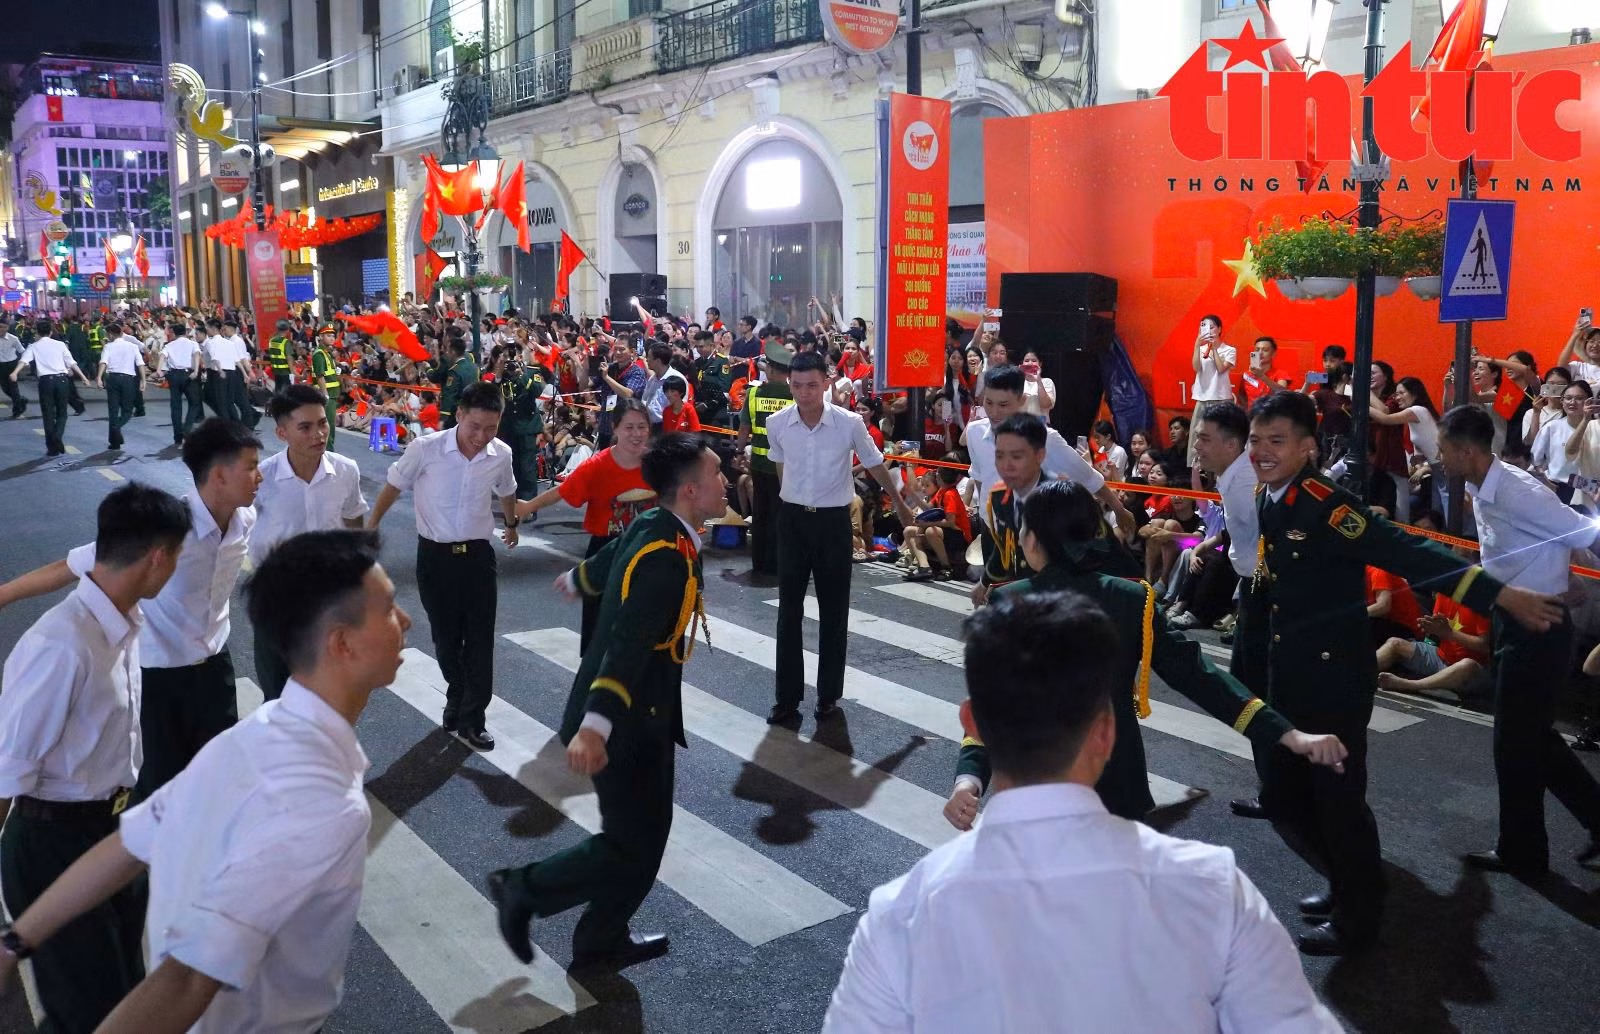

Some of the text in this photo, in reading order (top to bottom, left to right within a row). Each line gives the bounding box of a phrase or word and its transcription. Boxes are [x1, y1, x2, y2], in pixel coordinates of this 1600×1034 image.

[835, 10, 869, 22] COMMITTED
[220, 169, 240, 177] Bank
[969, 231, 984, 239] QUAN
[678, 241, 690, 254] 30
